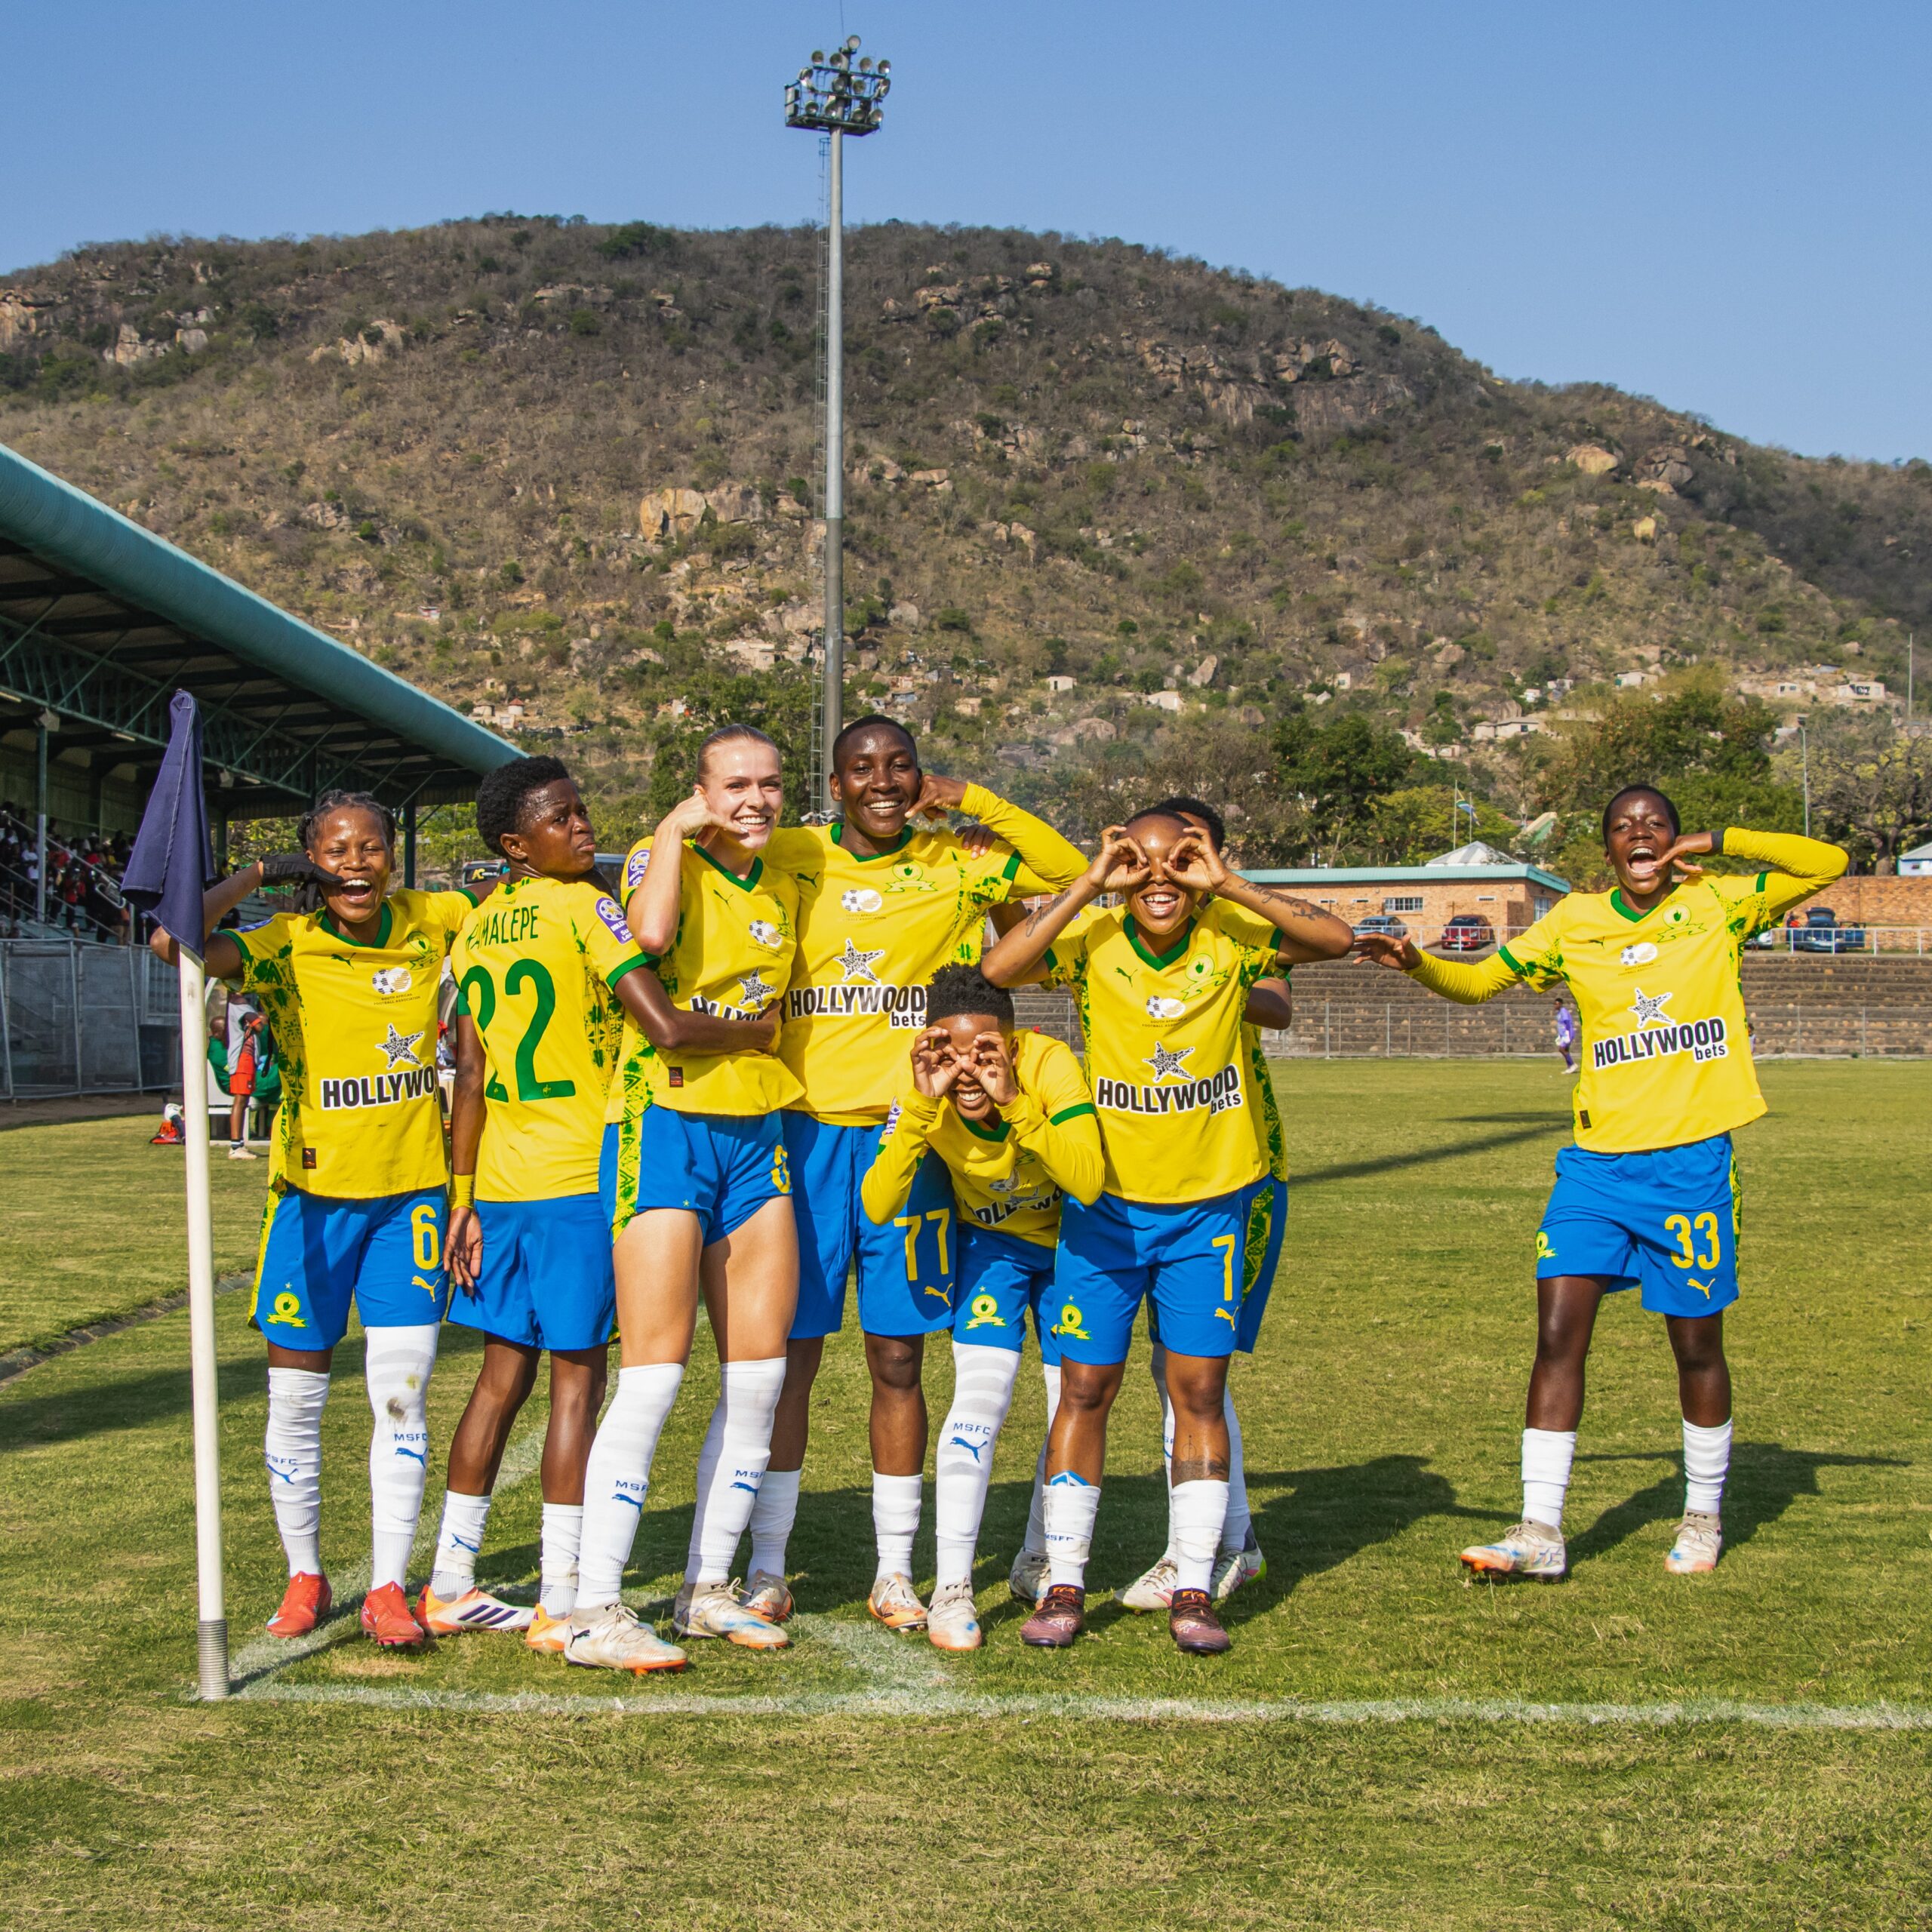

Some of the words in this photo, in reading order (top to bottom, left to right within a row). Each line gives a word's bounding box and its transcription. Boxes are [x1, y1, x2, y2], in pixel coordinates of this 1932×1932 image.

[789, 986, 926, 1018] HOLLYWOOD
[891, 1012, 926, 1027] bets
[461, 958, 576, 1103] 22
[1594, 1017, 1725, 1068] HOLLYWOOD
[1694, 1044, 1725, 1061] bets
[1098, 1064, 1239, 1113] HOLLYWOOD
[1210, 1093, 1241, 1115] bets
[411, 1204, 439, 1270] 6
[894, 1208, 949, 1281] 77
[1664, 1211, 1720, 1270] 33
[1211, 1233, 1235, 1302] 7
[953, 1422, 991, 1435] MSFC
